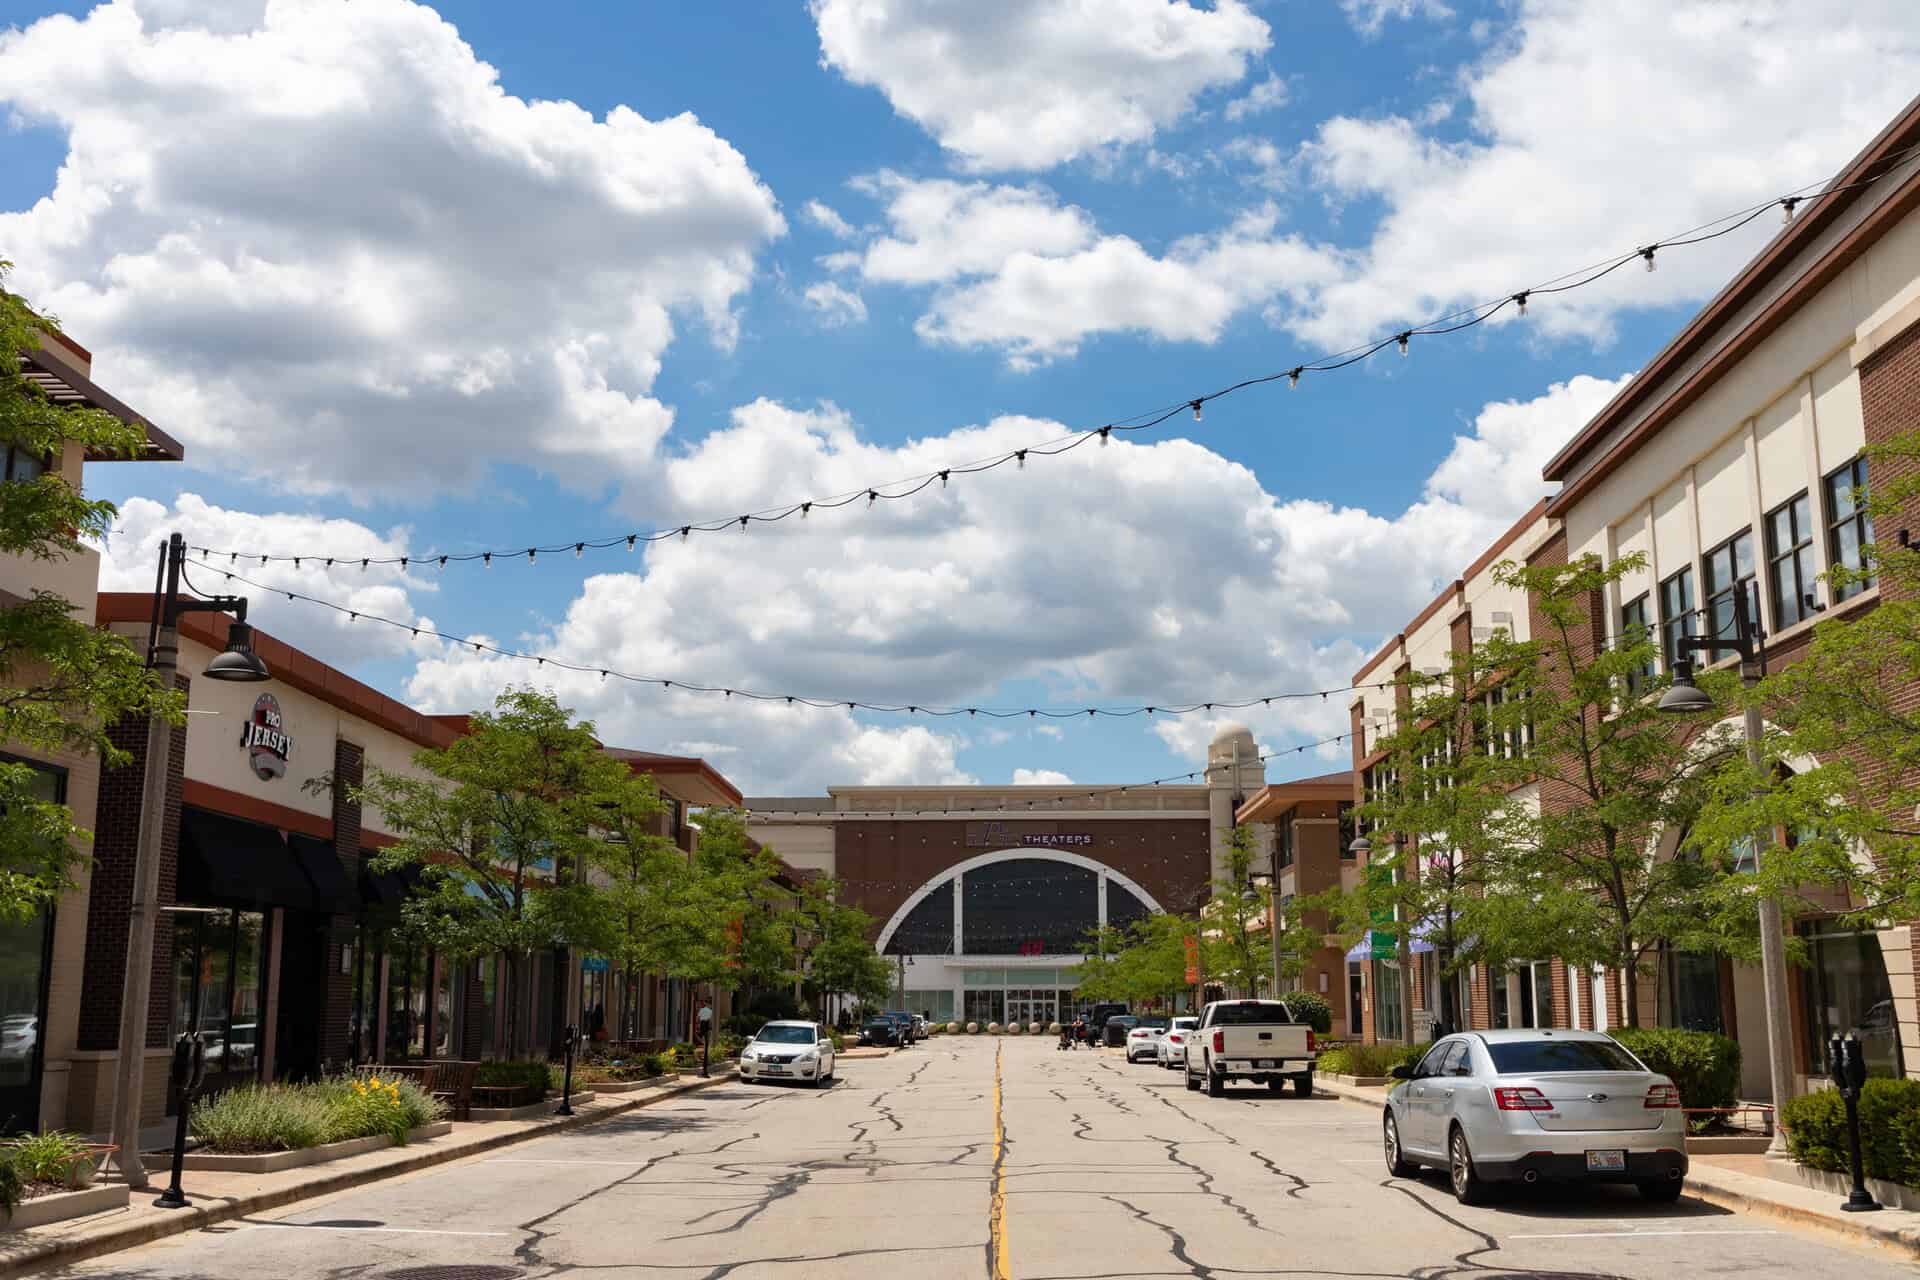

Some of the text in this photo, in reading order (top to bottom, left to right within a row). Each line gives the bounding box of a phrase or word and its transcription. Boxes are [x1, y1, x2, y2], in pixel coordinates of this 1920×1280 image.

[266, 710, 281, 728] PRO
[245, 721, 294, 761] JERSEY
[1024, 835, 1092, 844] THEATERS
